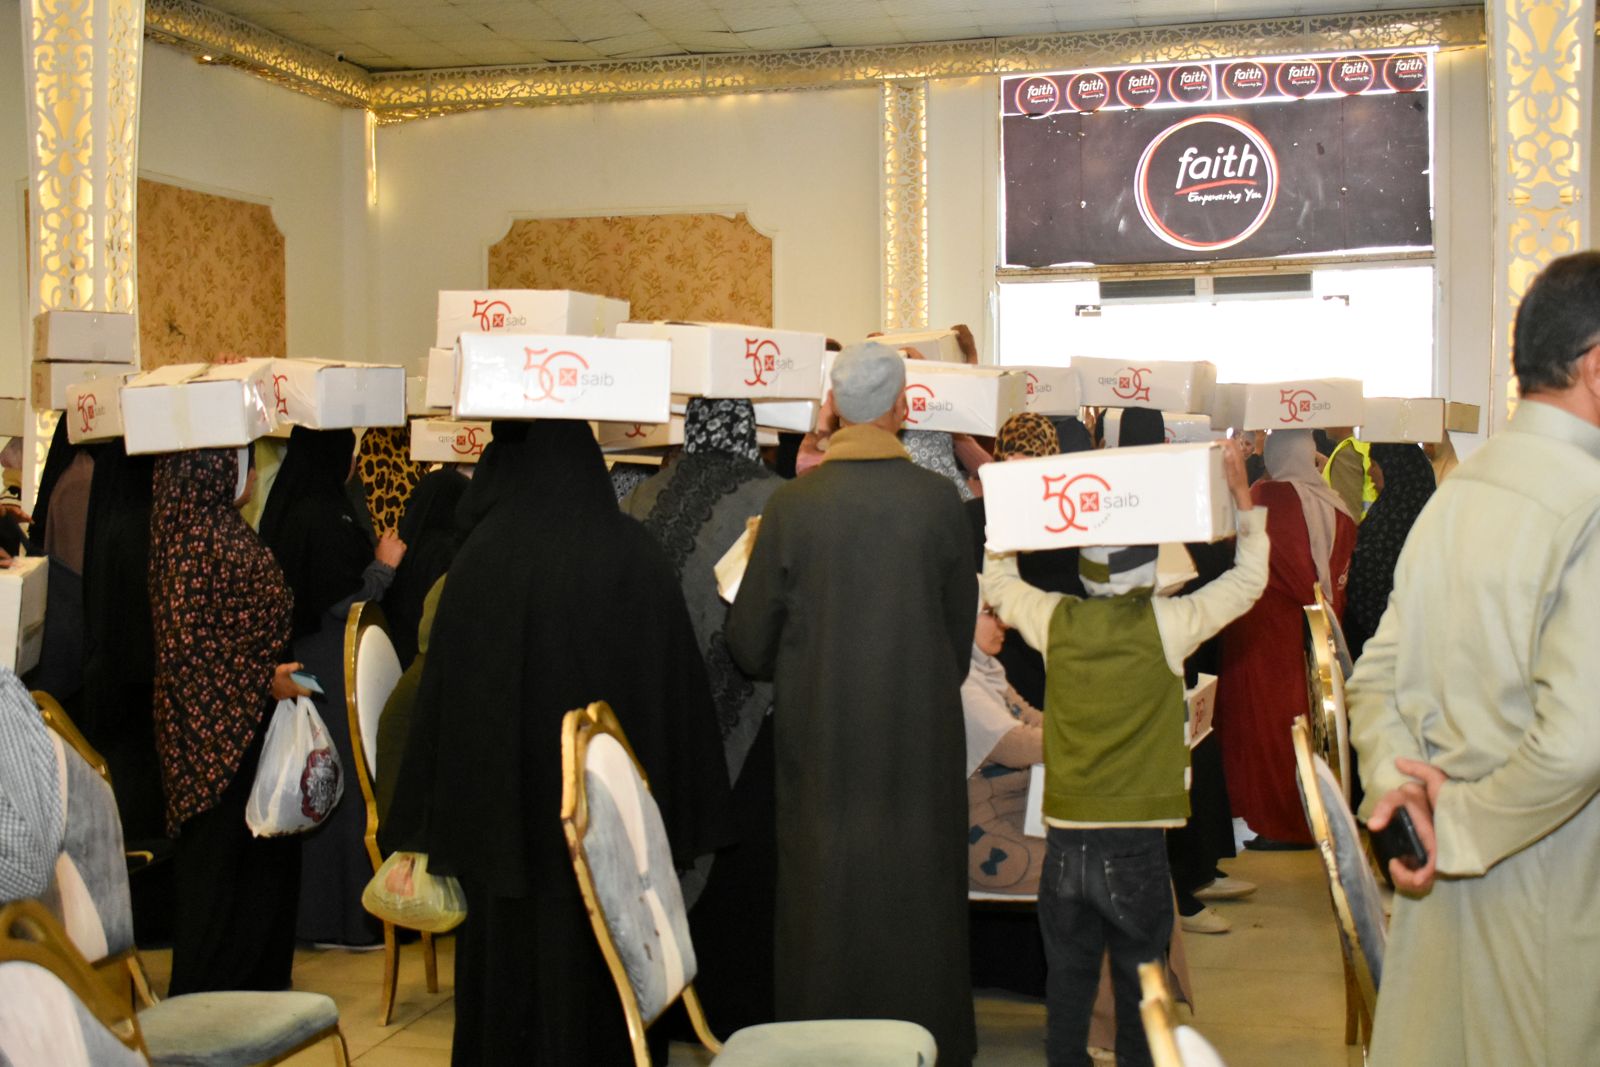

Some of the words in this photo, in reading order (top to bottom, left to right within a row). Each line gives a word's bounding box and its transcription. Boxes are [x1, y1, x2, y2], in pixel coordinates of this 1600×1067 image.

[1288, 64, 1315, 80] faith
[1341, 61, 1369, 77] faith
[1395, 59, 1423, 74] faith
[1128, 74, 1155, 91] faith
[1180, 71, 1207, 86] faith
[1233, 68, 1262, 83] faith
[1027, 84, 1053, 99] faith
[1078, 79, 1104, 95] faith
[1175, 143, 1258, 189] faith
[1187, 190, 1242, 206] Empowering
[1244, 187, 1262, 202] You
[506, 316, 527, 326] saib
[523, 346, 590, 403] 50
[581, 371, 615, 387] saib
[928, 400, 953, 412] saib
[1041, 473, 1111, 533] 50
[1103, 491, 1140, 509] saib
